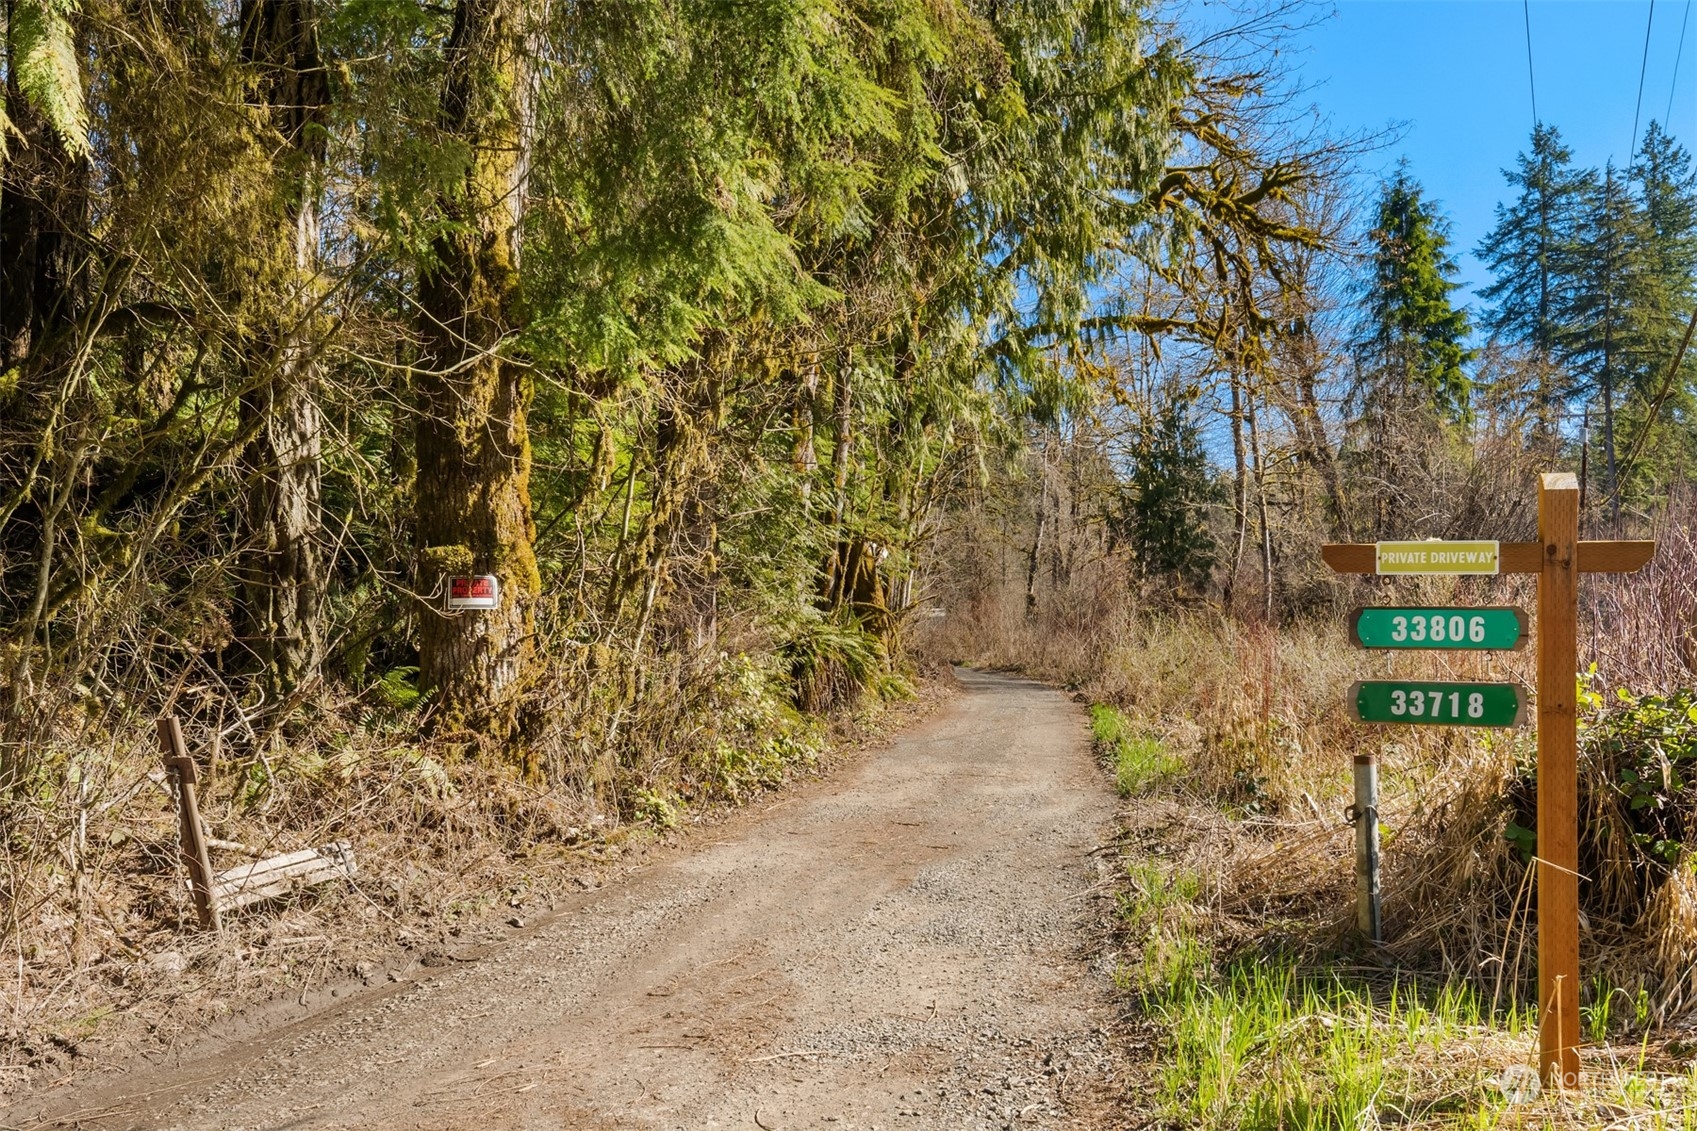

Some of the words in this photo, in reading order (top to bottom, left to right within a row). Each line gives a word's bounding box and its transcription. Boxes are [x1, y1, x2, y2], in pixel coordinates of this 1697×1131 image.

[1381, 551, 1427, 564] PRIVATE
[1430, 551, 1494, 564] DRIVEWAY
[453, 586, 493, 594] PROERTY
[1391, 615, 1486, 642] 33806
[1390, 689, 1484, 718] 33718
